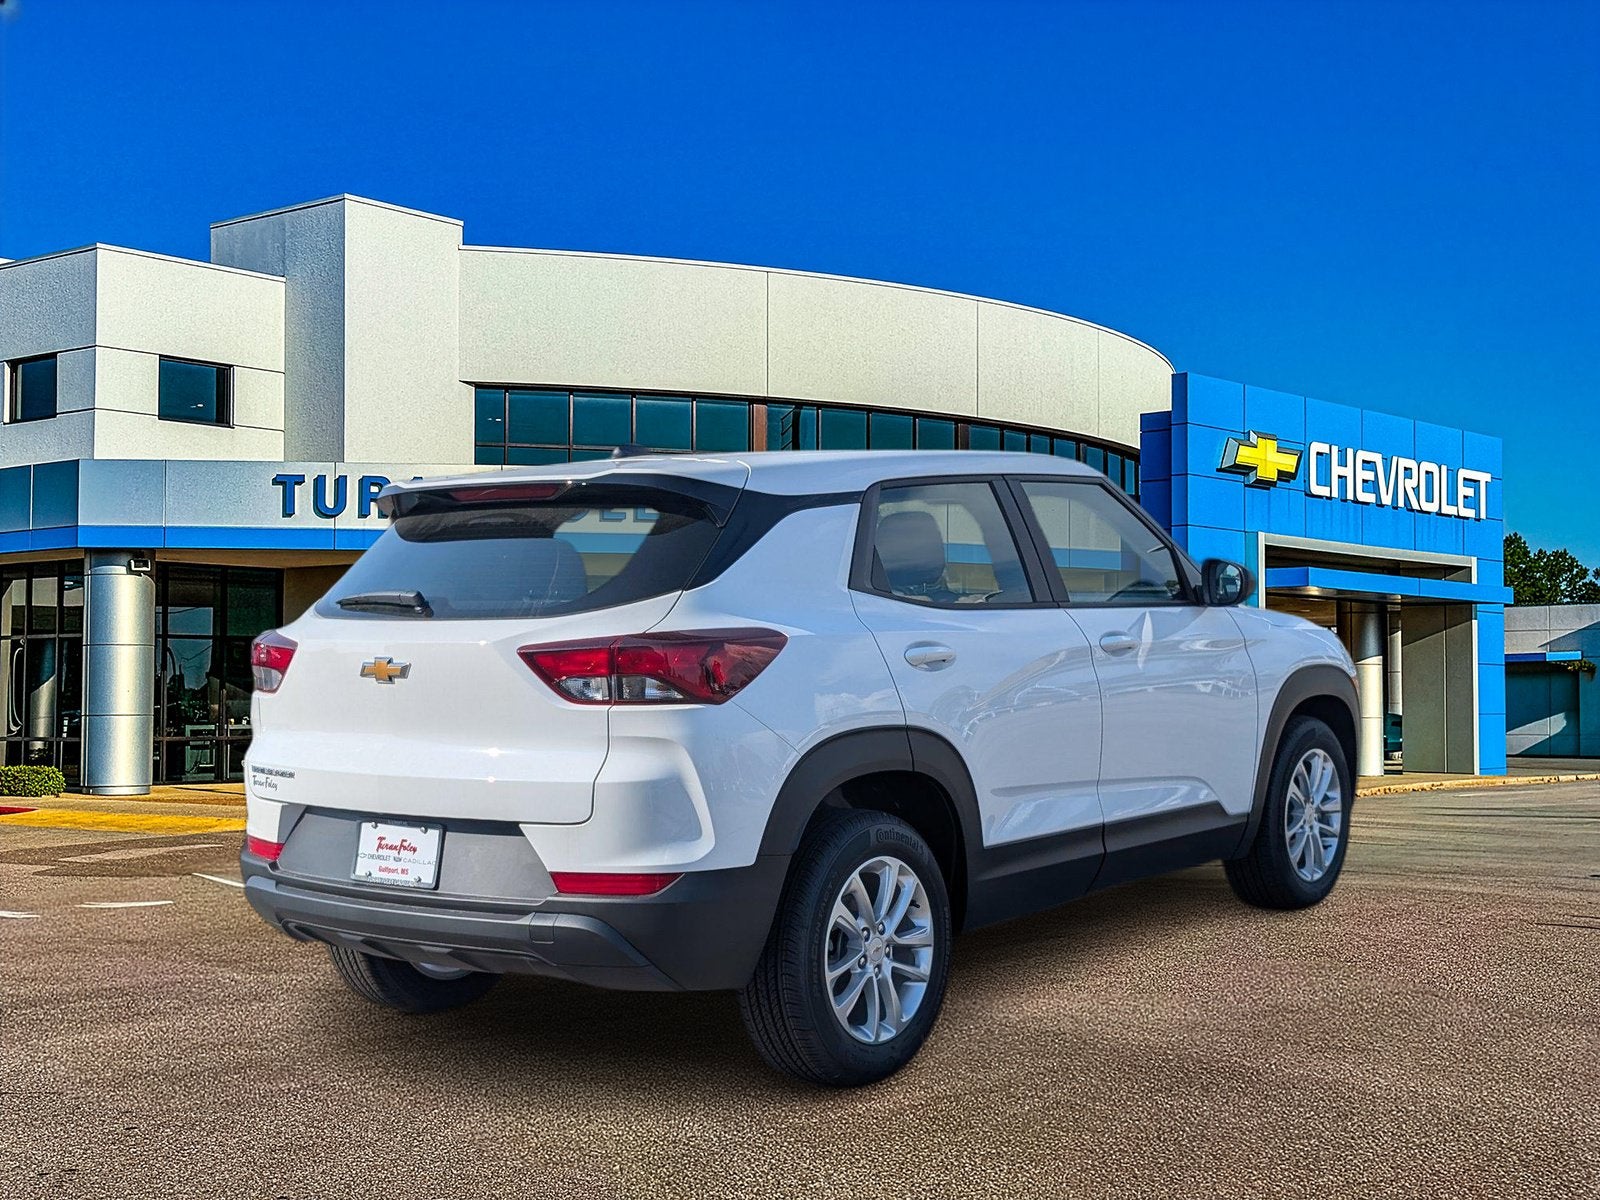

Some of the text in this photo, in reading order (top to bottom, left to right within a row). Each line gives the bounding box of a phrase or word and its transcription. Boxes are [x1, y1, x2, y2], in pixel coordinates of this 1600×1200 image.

[271, 473, 424, 519] TUR
[1309, 441, 1492, 520] CHEVROLET
[397, 838, 418, 856] Foley
[875, 827, 920, 849] Continental
